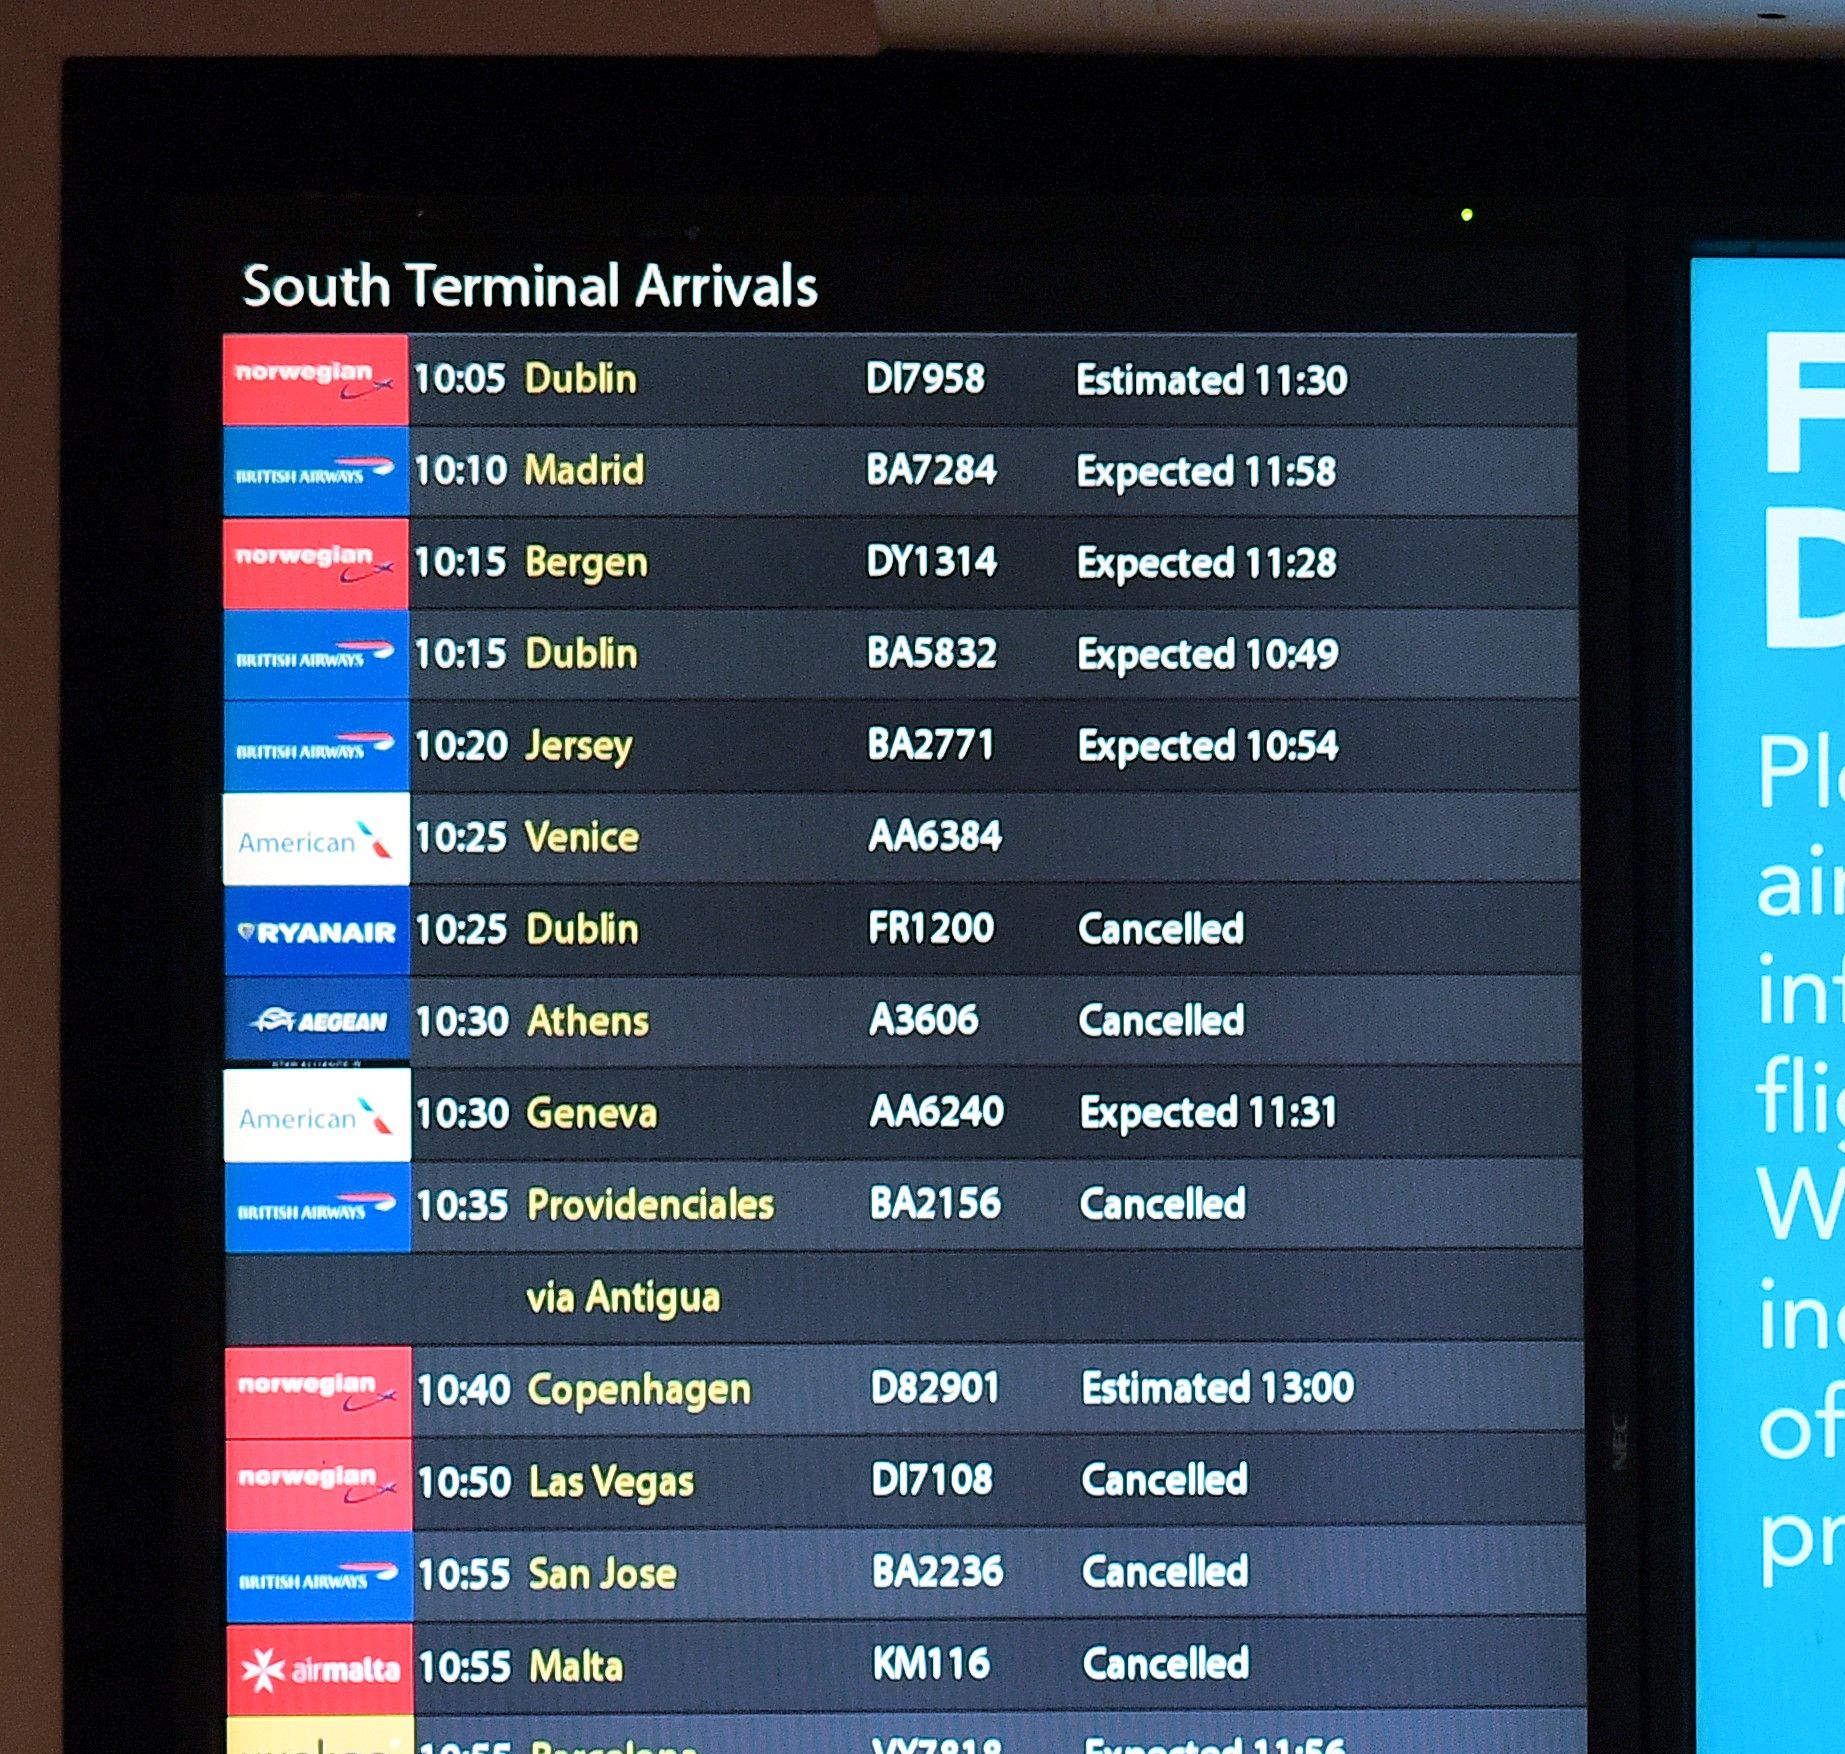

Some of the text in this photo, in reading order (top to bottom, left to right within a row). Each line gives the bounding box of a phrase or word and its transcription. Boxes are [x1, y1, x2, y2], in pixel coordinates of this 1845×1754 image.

[243, 259, 819, 309] South Terminal Arrivals
[236, 362, 373, 385] norwegian
[414, 360, 1349, 397] 10:05 Dublin DI7958 Estimated 11:30
[235, 468, 365, 485] BRITISH AIRWAYS
[414, 451, 1337, 497] 10:10 Madrid BA7284 Expected 11:58
[414, 542, 1338, 588] 10:15 Bergen DY1314 Expected 11:28
[414, 634, 1340, 680] 10:15 Dublin BA5832 Expected 10:49
[415, 725, 1340, 771] 10:20 Jersey BA2771 Expected 10:54
[238, 831, 356, 853] American
[416, 817, 1004, 856] 10:25 Venice AA6384
[257, 921, 397, 944] RYANAIR
[415, 909, 1245, 946] 10:25 Dublin FR1200 Cancelled
[297, 1012, 388, 1032] AEGEAN
[415, 1000, 1245, 1038] 10:30 Athens A3606 Cancelled
[418, 1092, 1336, 1138] 10:30 Geneva AA6240 Expected 11:31
[416, 1184, 1247, 1223] 10:35 Providenciales BA2156 Cancelled
[525, 1278, 721, 1322] via Antigua
[417, 1368, 1356, 1415] 10:40 Copenhagen D82901 Estimated 13:00
[417, 1460, 1249, 1507] 10:50 Las Vegas DI7108 Cancelled
[418, 1552, 1249, 1592] 10:55 San Jose BA2236 Cancelled
[291, 1655, 401, 1683] airmalta
